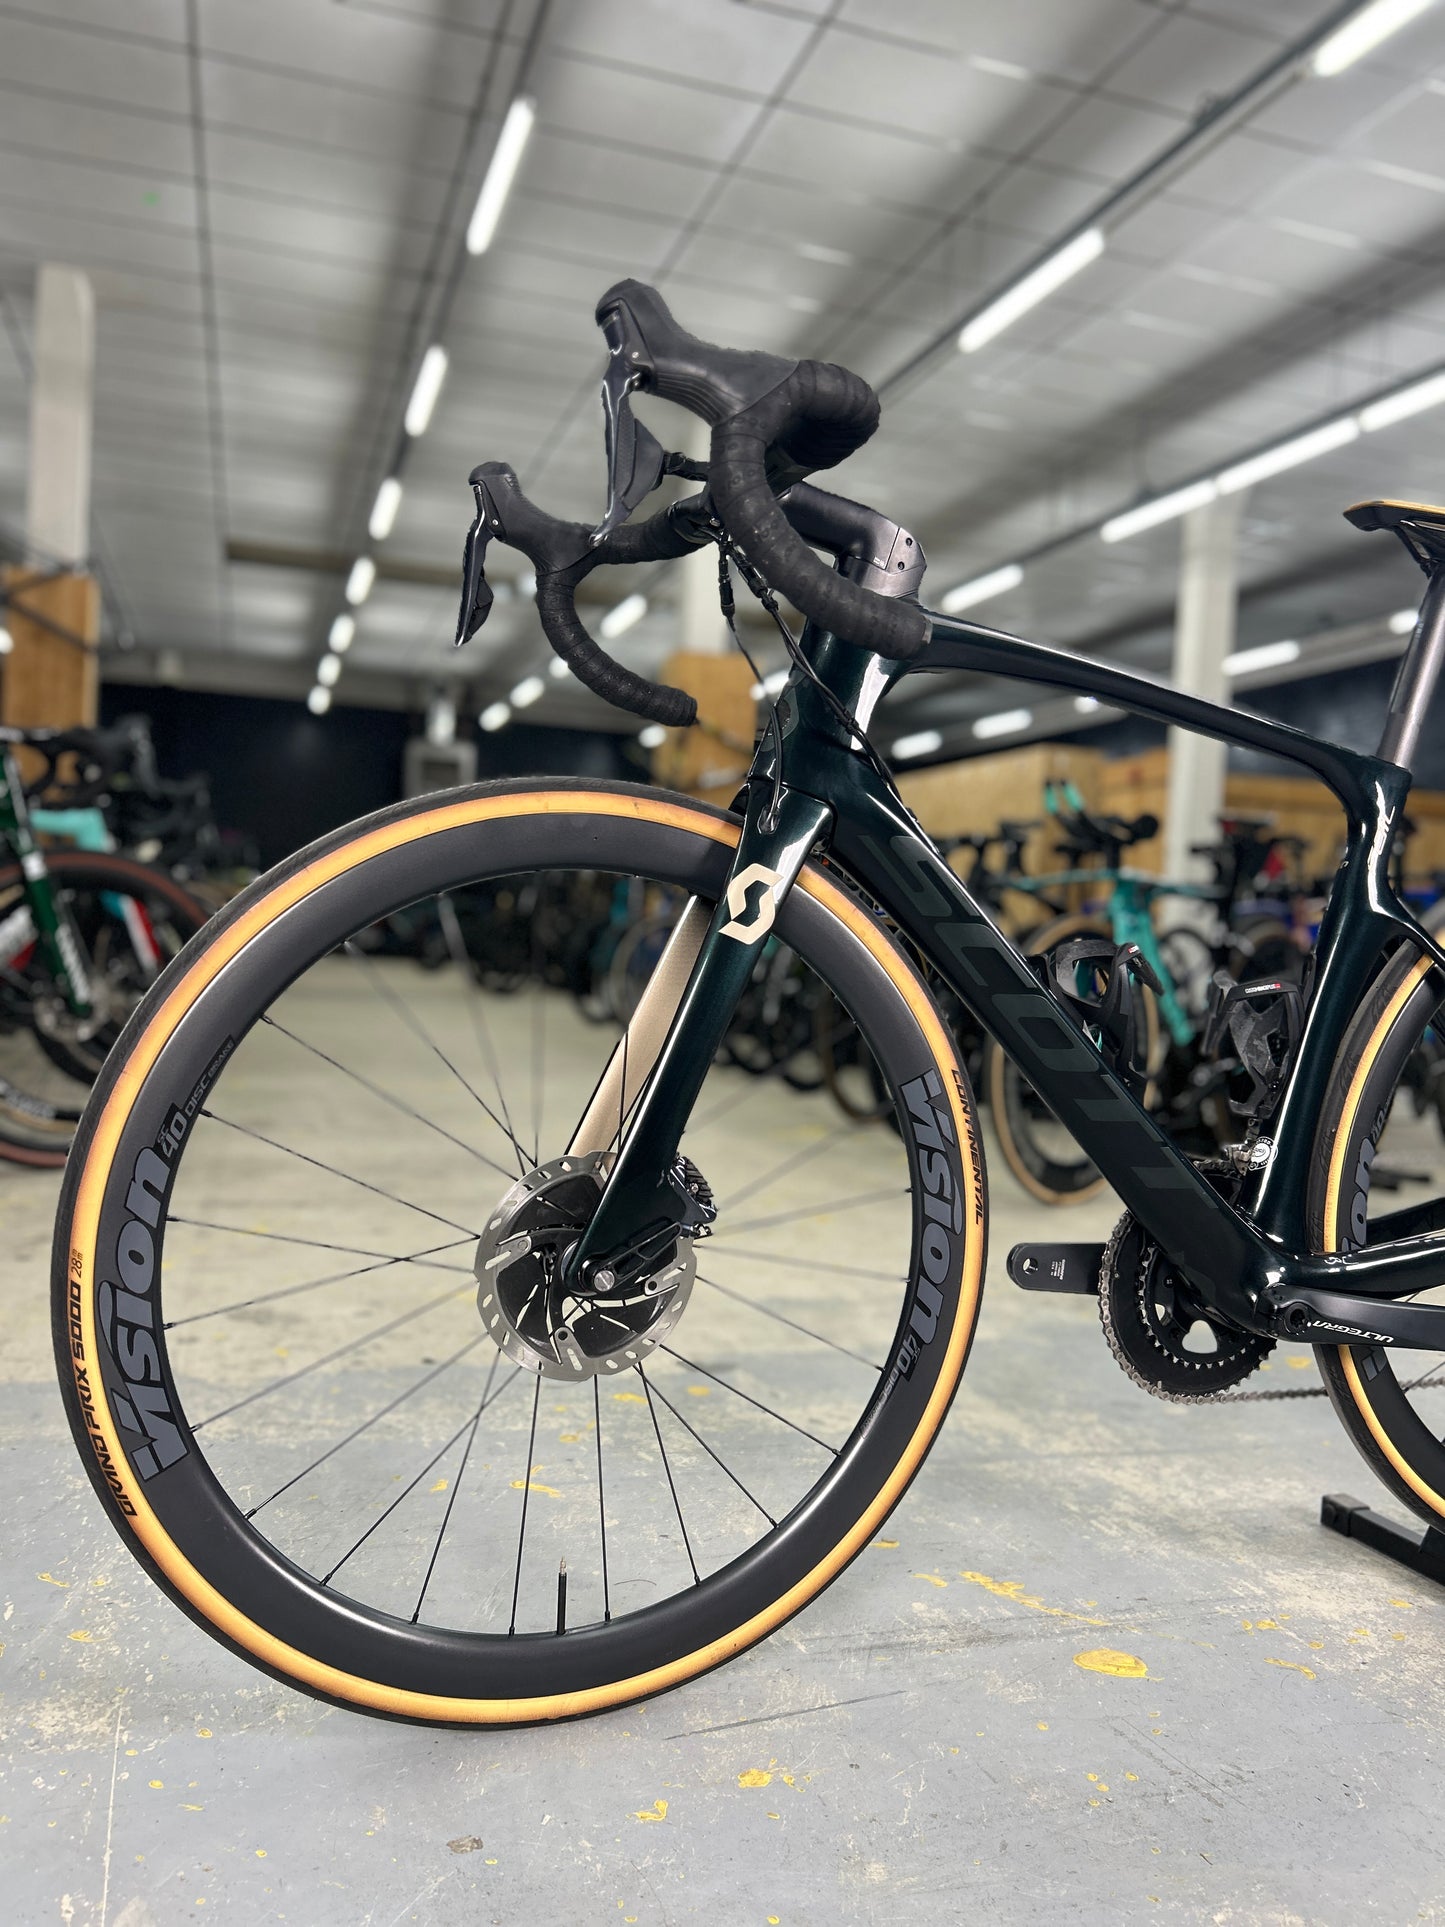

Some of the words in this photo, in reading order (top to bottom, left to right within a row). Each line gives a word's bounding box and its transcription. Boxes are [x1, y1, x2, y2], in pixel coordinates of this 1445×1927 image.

[858, 834, 1220, 1210] SCOTT
[161, 1111, 188, 1157] 40
[185, 1074, 211, 1117] DISC
[950, 1068, 985, 1226] CONTINENTAL
[69, 1279, 86, 1362] 5000
[896, 1334, 917, 1374] 40
[1312, 1320, 1395, 1344] ULTEGRA
[75, 1363, 100, 1431] PRIX
[91, 1433, 138, 1517] GRAND
